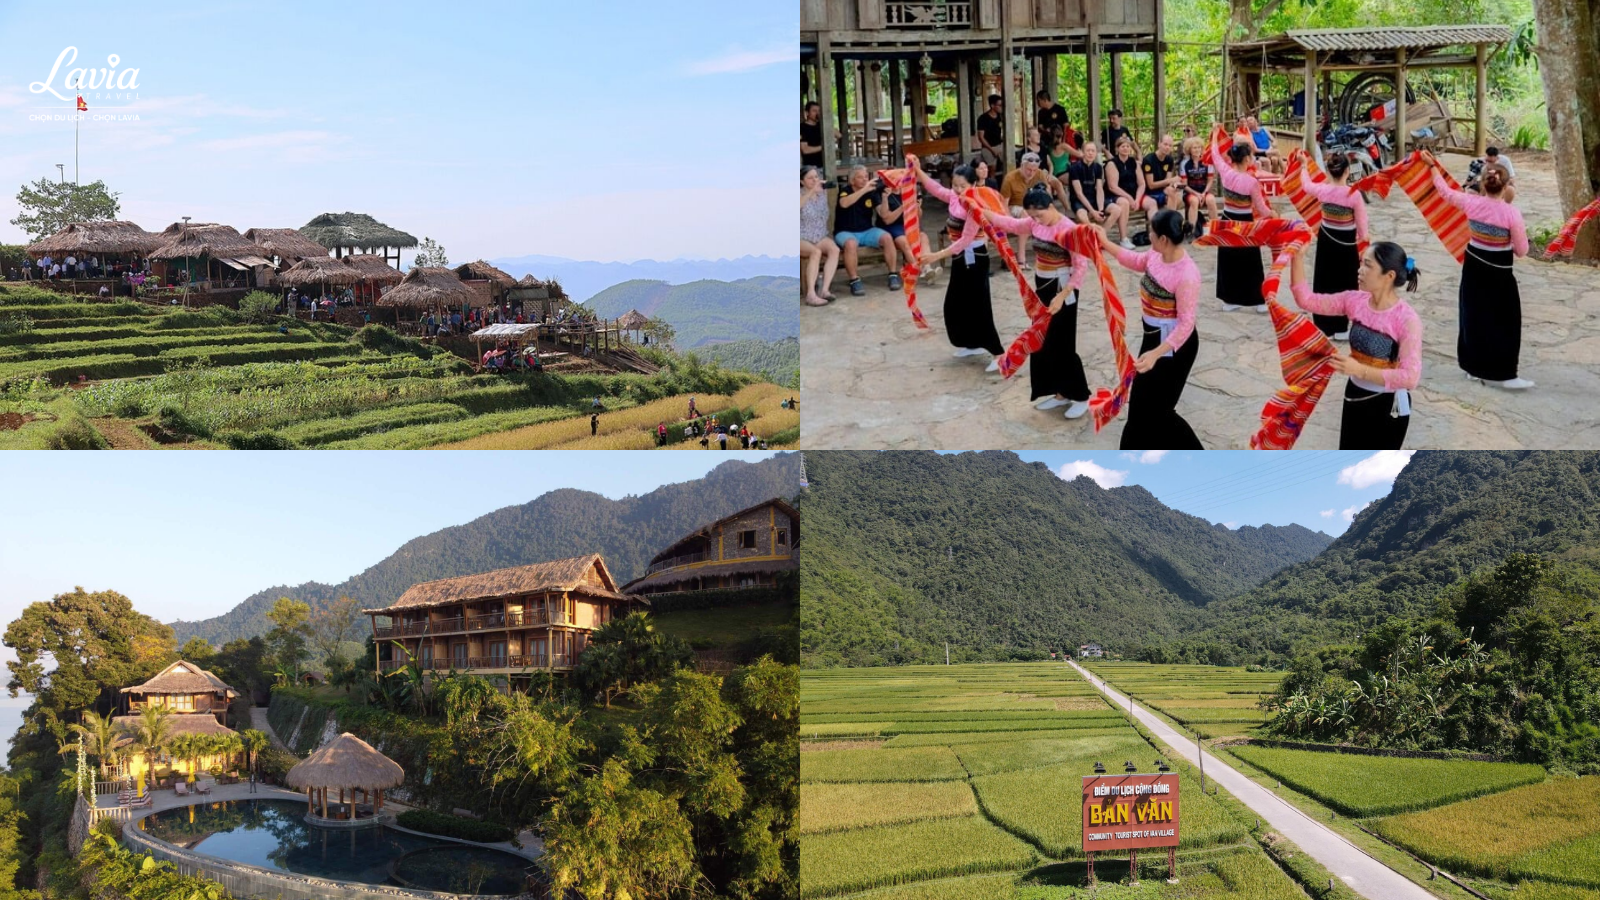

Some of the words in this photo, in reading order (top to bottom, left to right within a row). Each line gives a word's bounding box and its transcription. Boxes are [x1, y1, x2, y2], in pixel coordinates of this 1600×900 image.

[1111, 786, 1120, 795] DU
[1121, 785, 1134, 796] LỊCH
[1135, 783, 1152, 796] CỘNG
[1090, 798, 1129, 824] BẢN
[1136, 797, 1173, 822] VĂN
[1088, 832, 1113, 841] COMMUNITY
[1115, 831, 1132, 839] TOURIST
[1132, 830, 1143, 838] SPOT
[1158, 828, 1175, 836] VILLAGE
